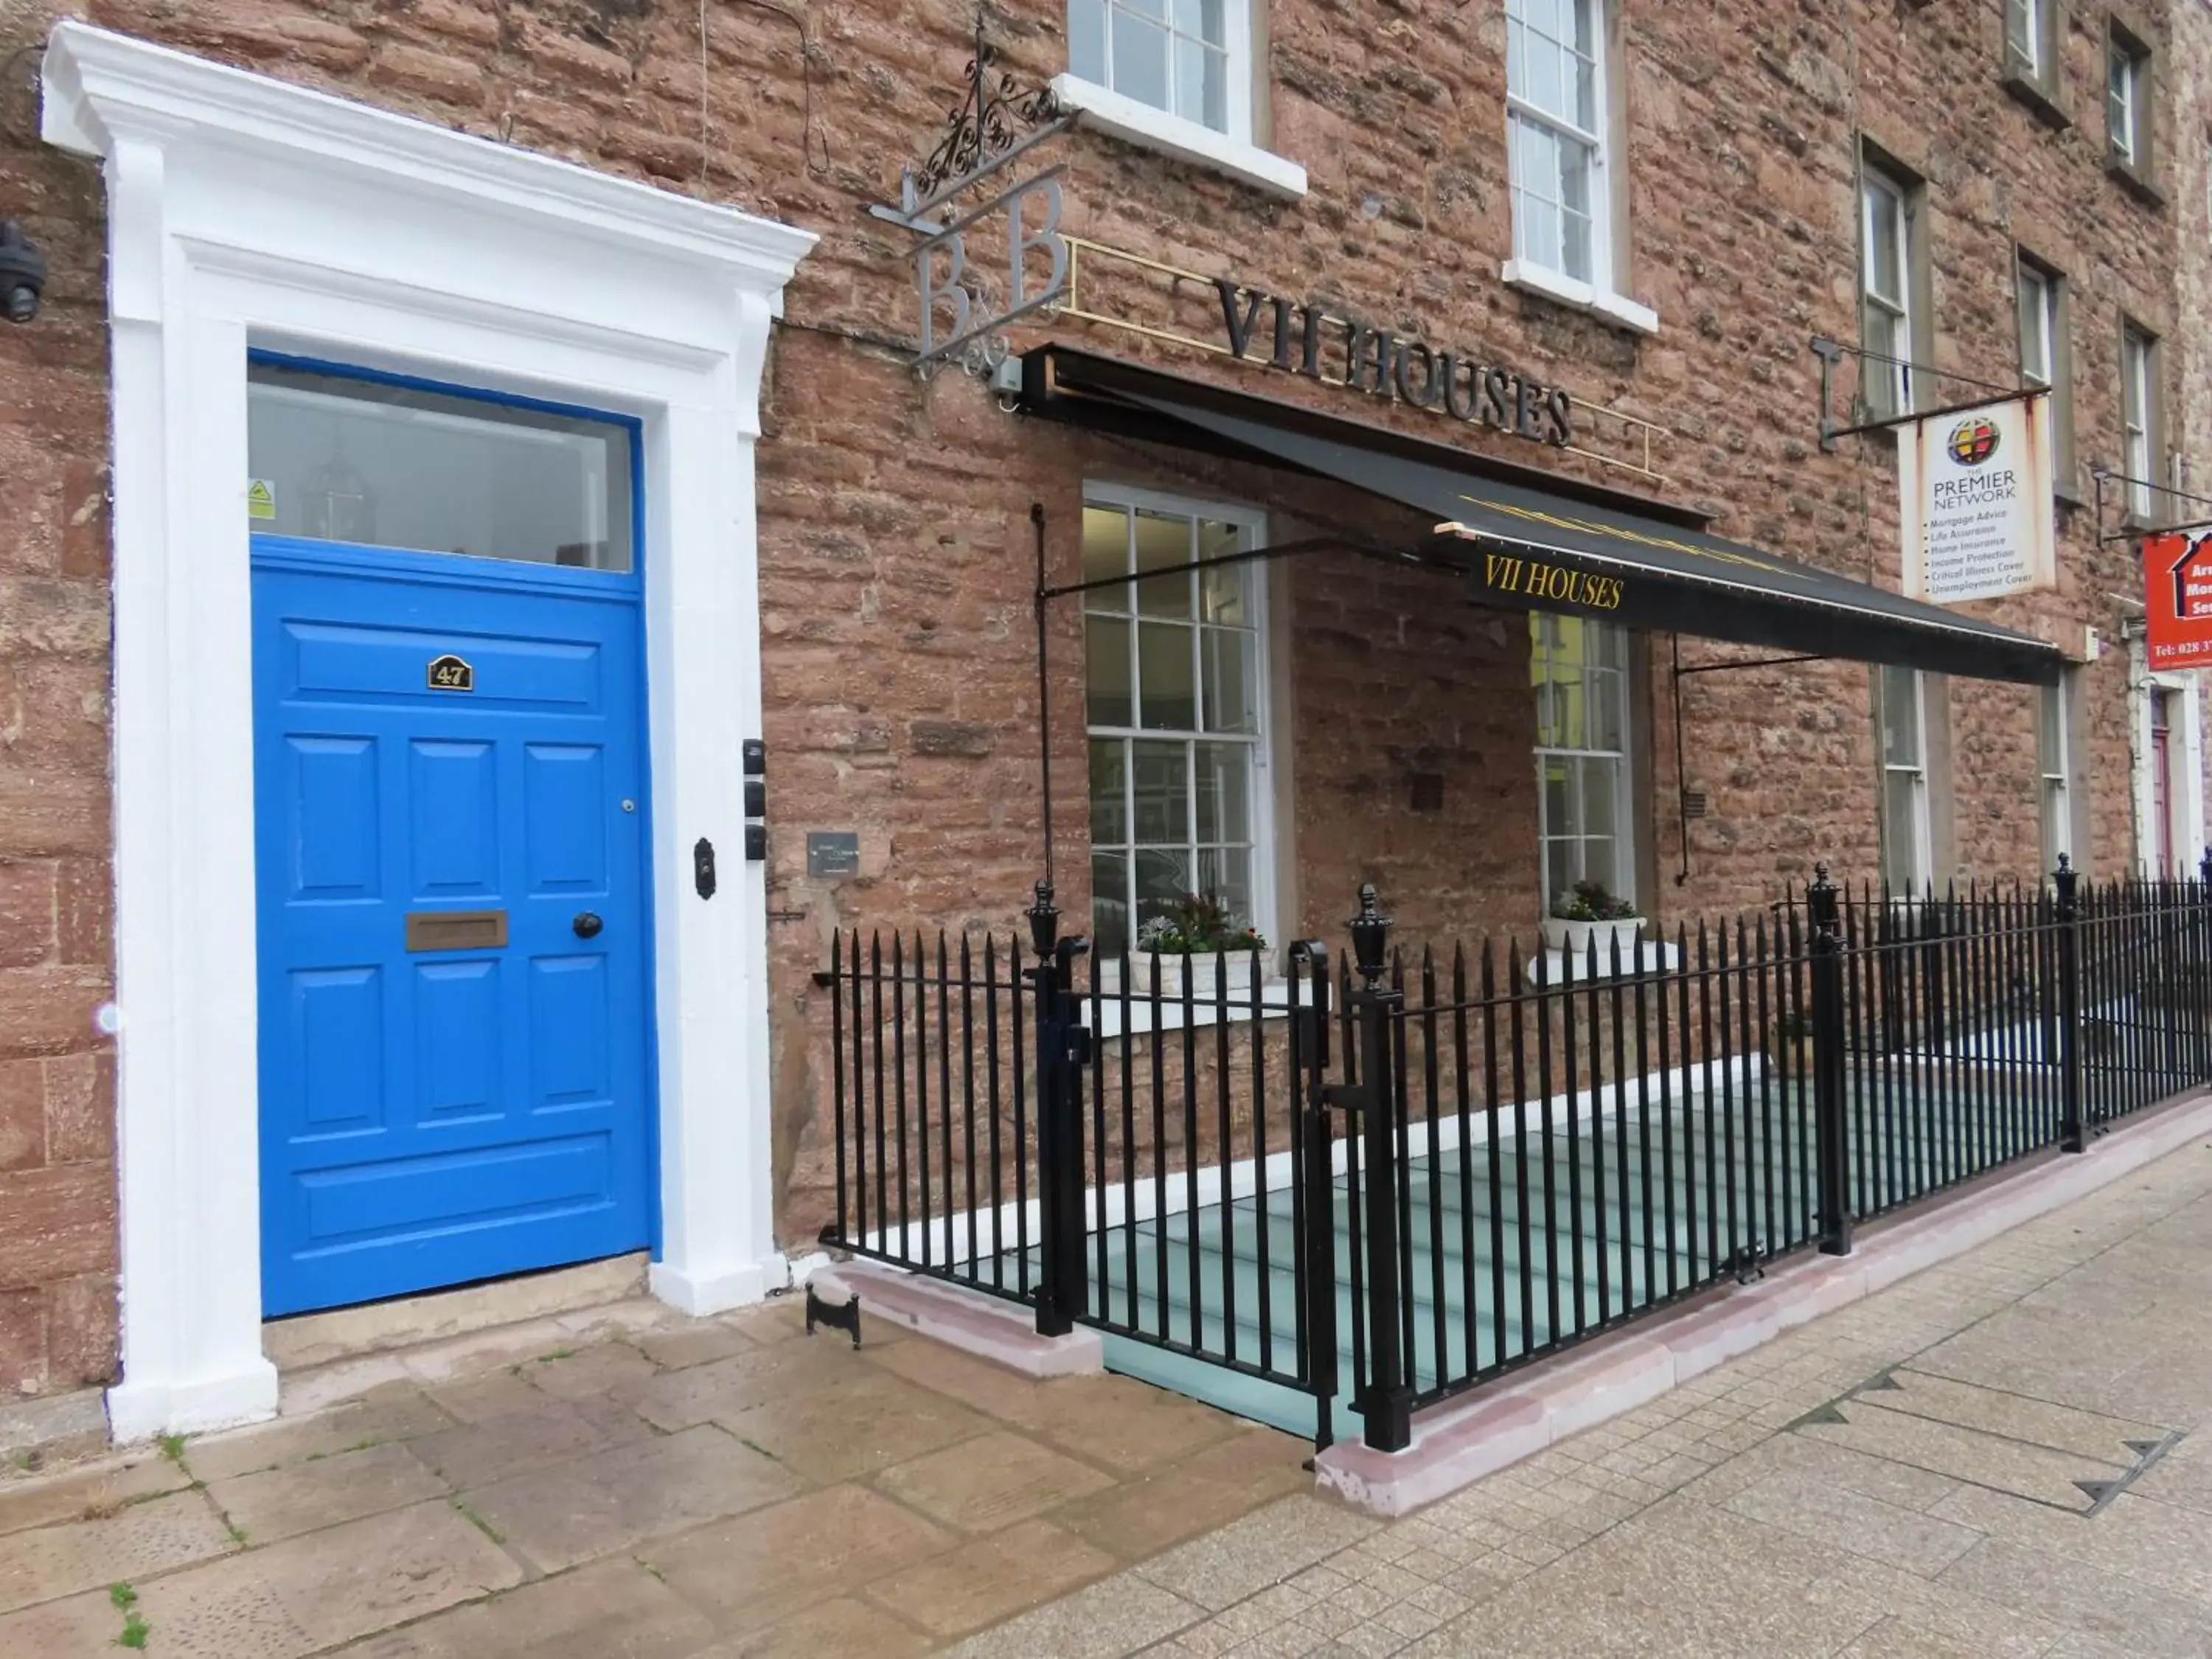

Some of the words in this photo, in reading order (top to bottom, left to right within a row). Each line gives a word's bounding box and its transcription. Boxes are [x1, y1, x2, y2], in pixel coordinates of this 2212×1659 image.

[1212, 279, 1322, 378] VII
[1346, 321, 1571, 448] HOUSES
[1934, 470, 2017, 498] PREMIER
[1934, 487, 2016, 510] NETWORK
[1930, 515, 1974, 528] Mortgage
[1977, 510, 2007, 521] Advice
[1930, 532, 1947, 542] Life
[1960, 538, 2006, 551] Insurance
[1931, 557, 1964, 568] Income
[1966, 550, 2015, 563] Protection
[1931, 569, 1964, 581] Critical
[1965, 566, 1994, 577] Illness
[1997, 561, 2024, 572] Cover
[1486, 554, 1524, 591] VII
[1525, 563, 1624, 609] HOUSES
[1932, 578, 2003, 594] Unemployment
[2005, 574, 2032, 585] Cover
[2154, 645, 2175, 657] Tel:
[2179, 641, 2199, 655] 028
[436, 666, 465, 685] 47
